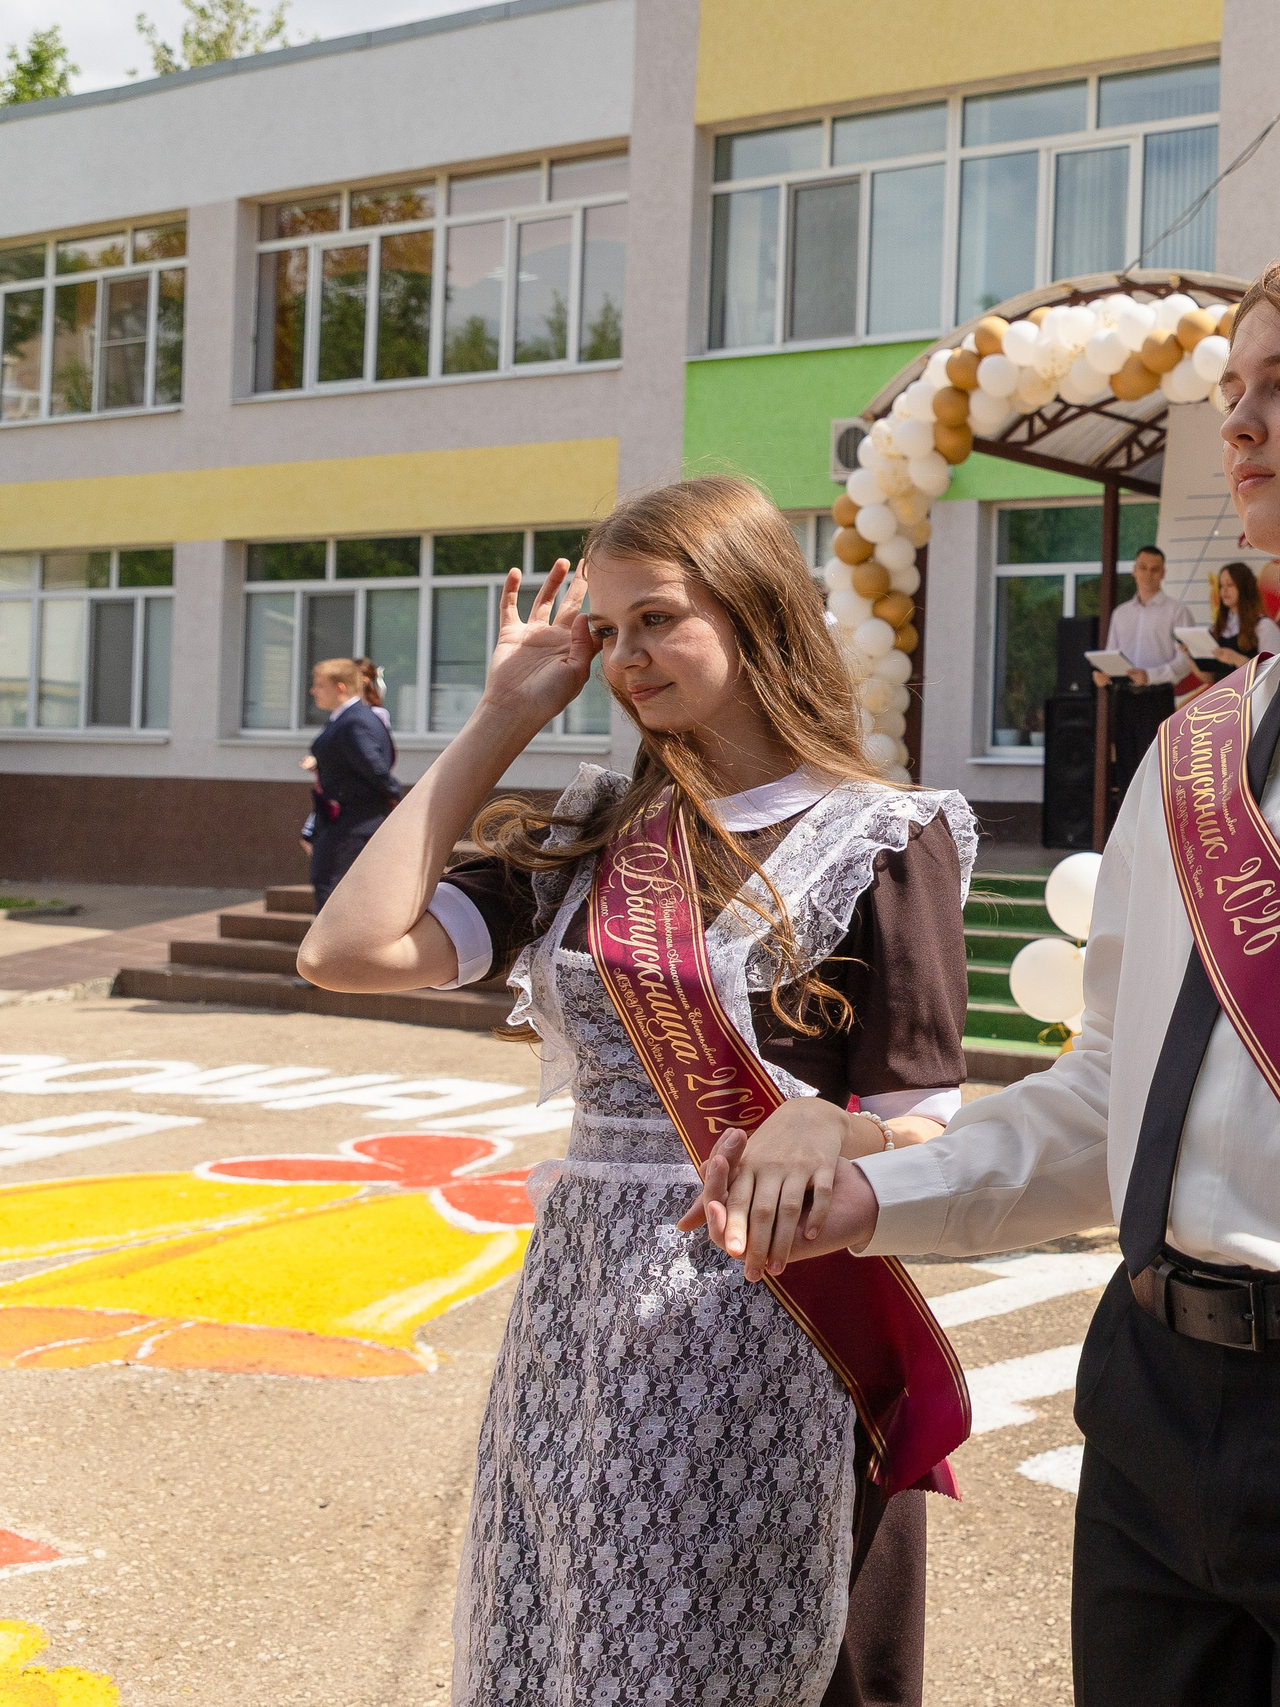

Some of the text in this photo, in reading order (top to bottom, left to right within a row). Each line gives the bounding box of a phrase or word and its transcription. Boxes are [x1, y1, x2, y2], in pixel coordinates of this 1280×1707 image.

[1173, 687, 1241, 860] Выпускник
[604, 841, 765, 1138] Выпускница 202
[613, 967, 640, 1008] МБОУ
[633, 1003, 649, 1040] Школа
[647, 1037, 666, 1063] №24
[663, 1066, 680, 1100] Самара
[666, 948, 691, 1010] Анастасия
[688, 1007, 718, 1066] Евгеньевна
